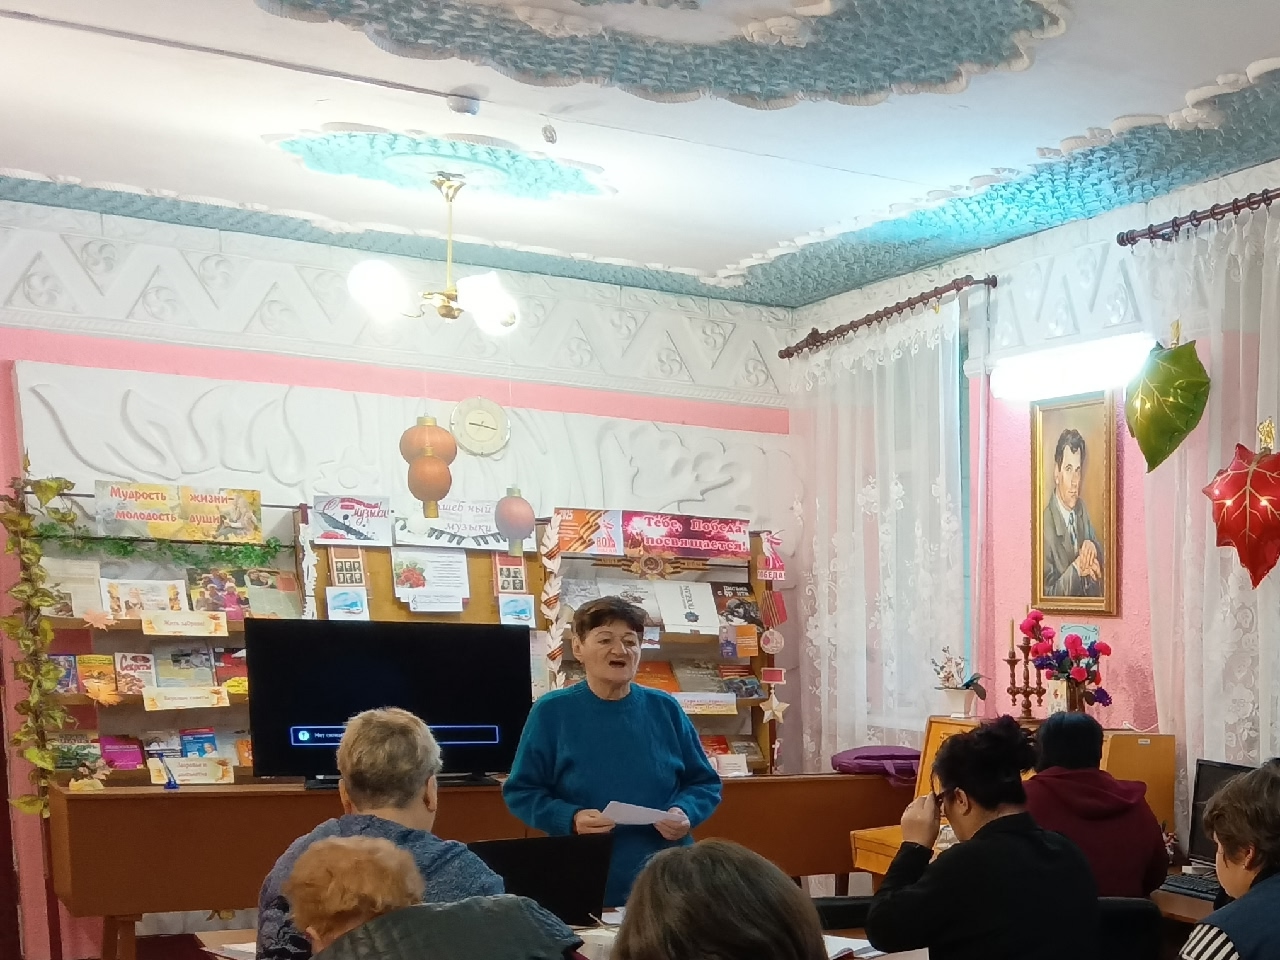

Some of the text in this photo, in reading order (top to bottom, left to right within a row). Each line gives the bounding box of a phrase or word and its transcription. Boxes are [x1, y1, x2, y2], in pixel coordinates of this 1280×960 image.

[110, 486, 167, 502] Мудрость
[116, 510, 220, 526] молодость души
[690, 519, 747, 536] Победа,
[644, 537, 748, 551] посвящается!
[119, 653, 152, 673] Секреты
